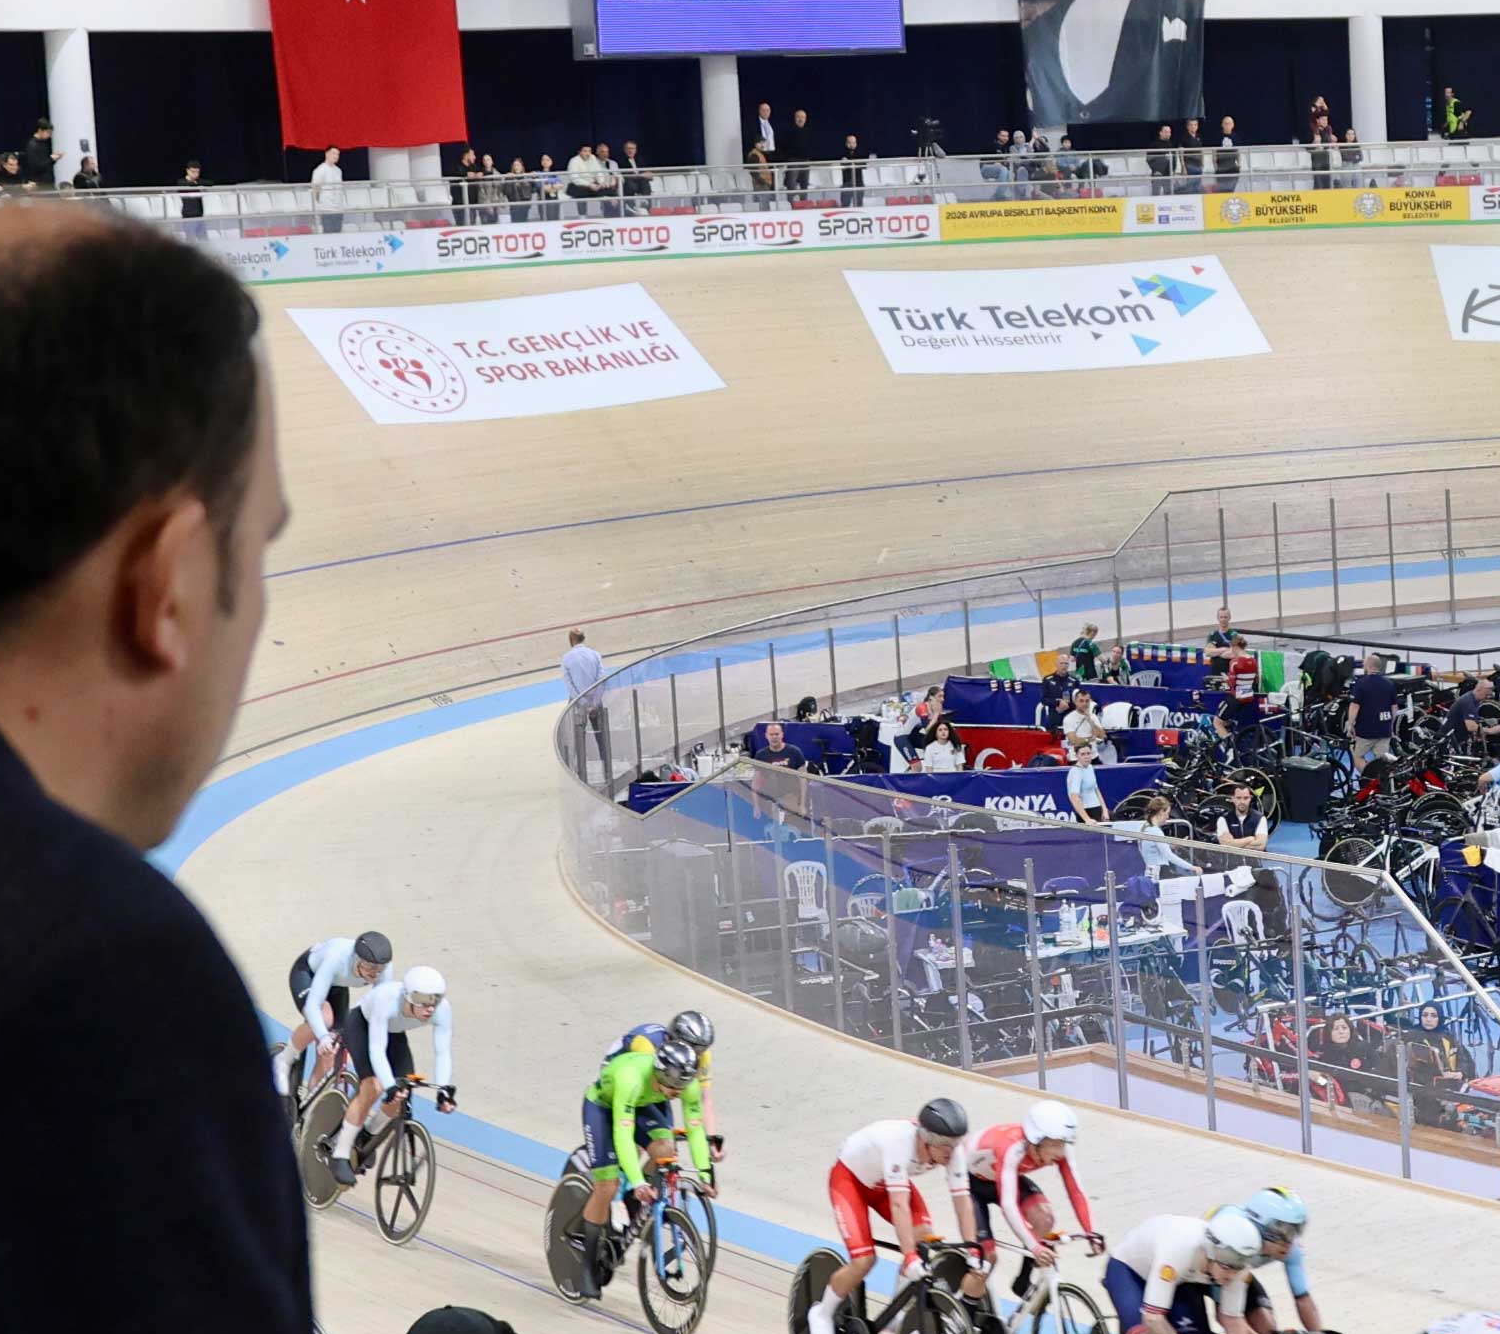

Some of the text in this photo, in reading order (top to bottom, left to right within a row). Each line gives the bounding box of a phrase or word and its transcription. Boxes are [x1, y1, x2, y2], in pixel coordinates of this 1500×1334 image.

[1271, 195, 1301, 203] KONYA
[1405, 190, 1436, 199] KONYA
[946, 210, 968, 220] 2026
[969, 208, 1002, 219] AVRUPA
[1044, 204, 1088, 217] BAŞKENTİ
[1088, 205, 1117, 215] KONYA
[1255, 203, 1318, 216] BÜYÜKŞEHİR
[1389, 200, 1452, 212] BÜYÜKŞEHİR
[314, 245, 386, 260] Türk Telekom
[879, 303, 1156, 331] Türk Telekom
[453, 320, 659, 359] T.C. GENÇLİK VE
[900, 332, 1063, 350] Değerli Hissettirir
[476, 342, 680, 384] SPOR BAKANLIĞI
[985, 794, 1057, 812] KONYA
